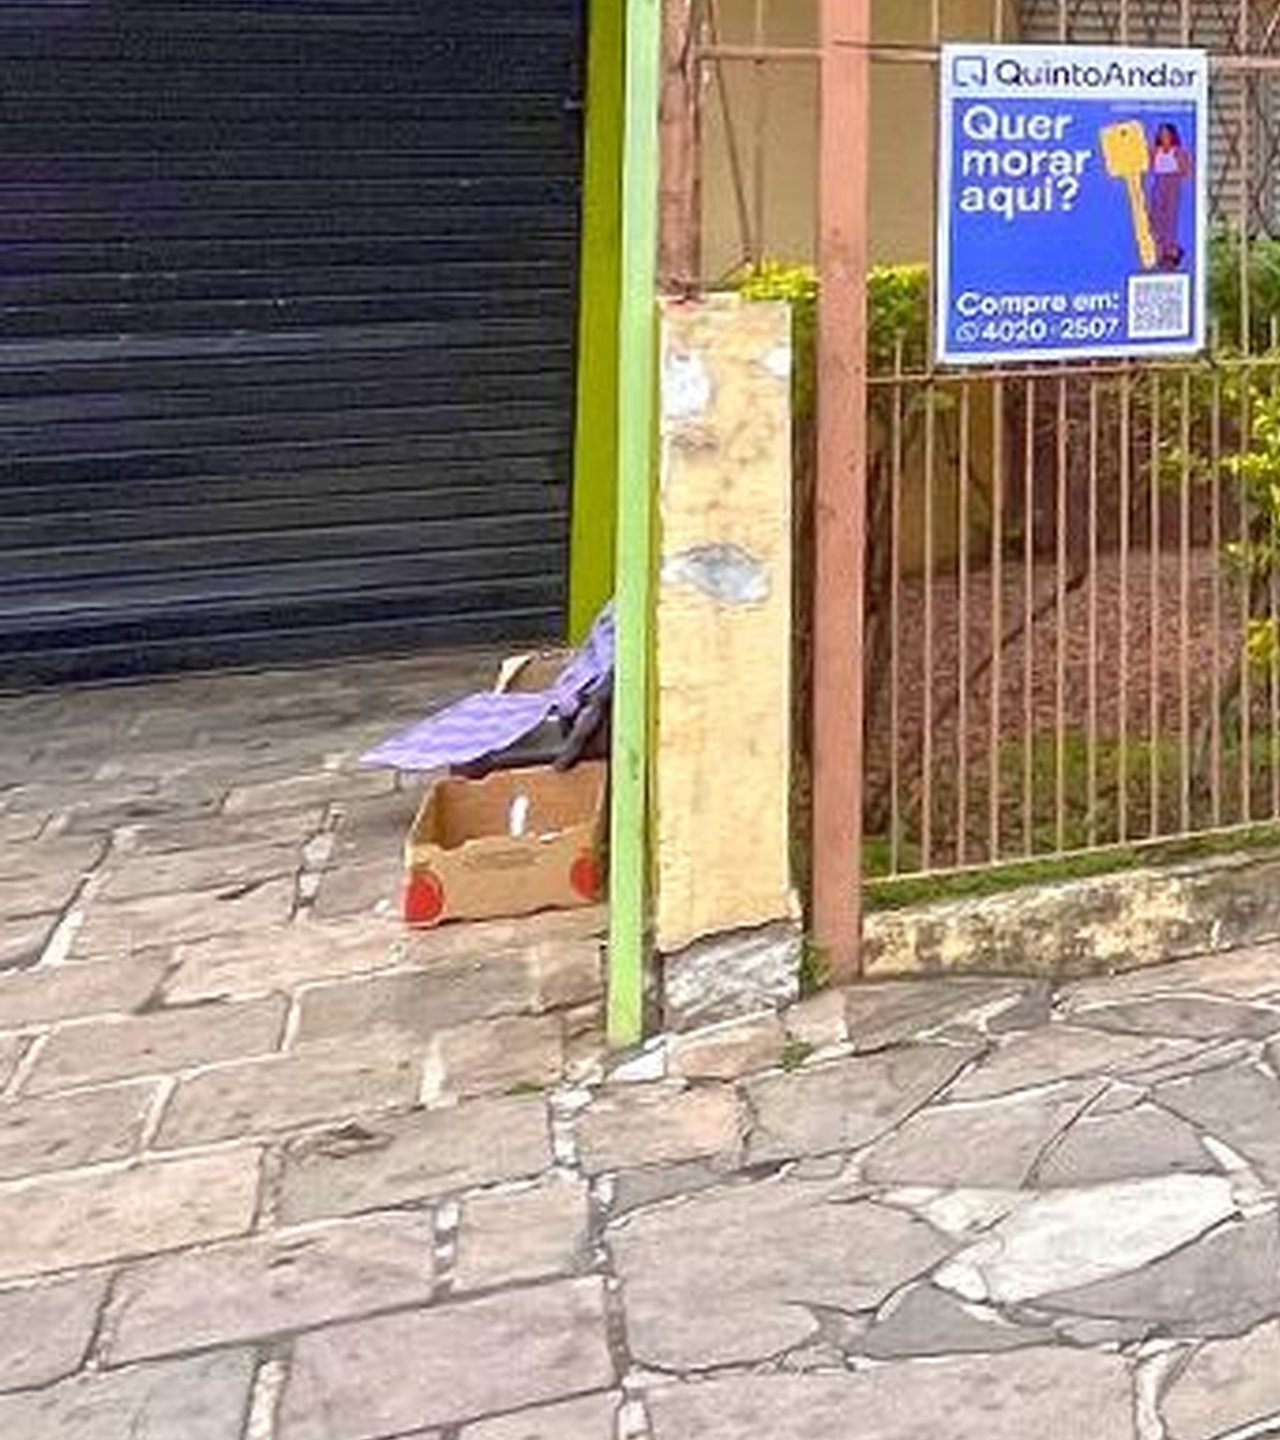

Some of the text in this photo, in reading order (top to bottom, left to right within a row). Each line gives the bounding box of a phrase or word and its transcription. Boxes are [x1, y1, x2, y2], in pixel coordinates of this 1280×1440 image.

[995, 58, 1197, 88] QuintoAndar
[961, 104, 1072, 141] Quer
[961, 148, 1093, 176] morar
[959, 176, 1079, 221] aqui?
[956, 291, 1119, 316] Compra em:
